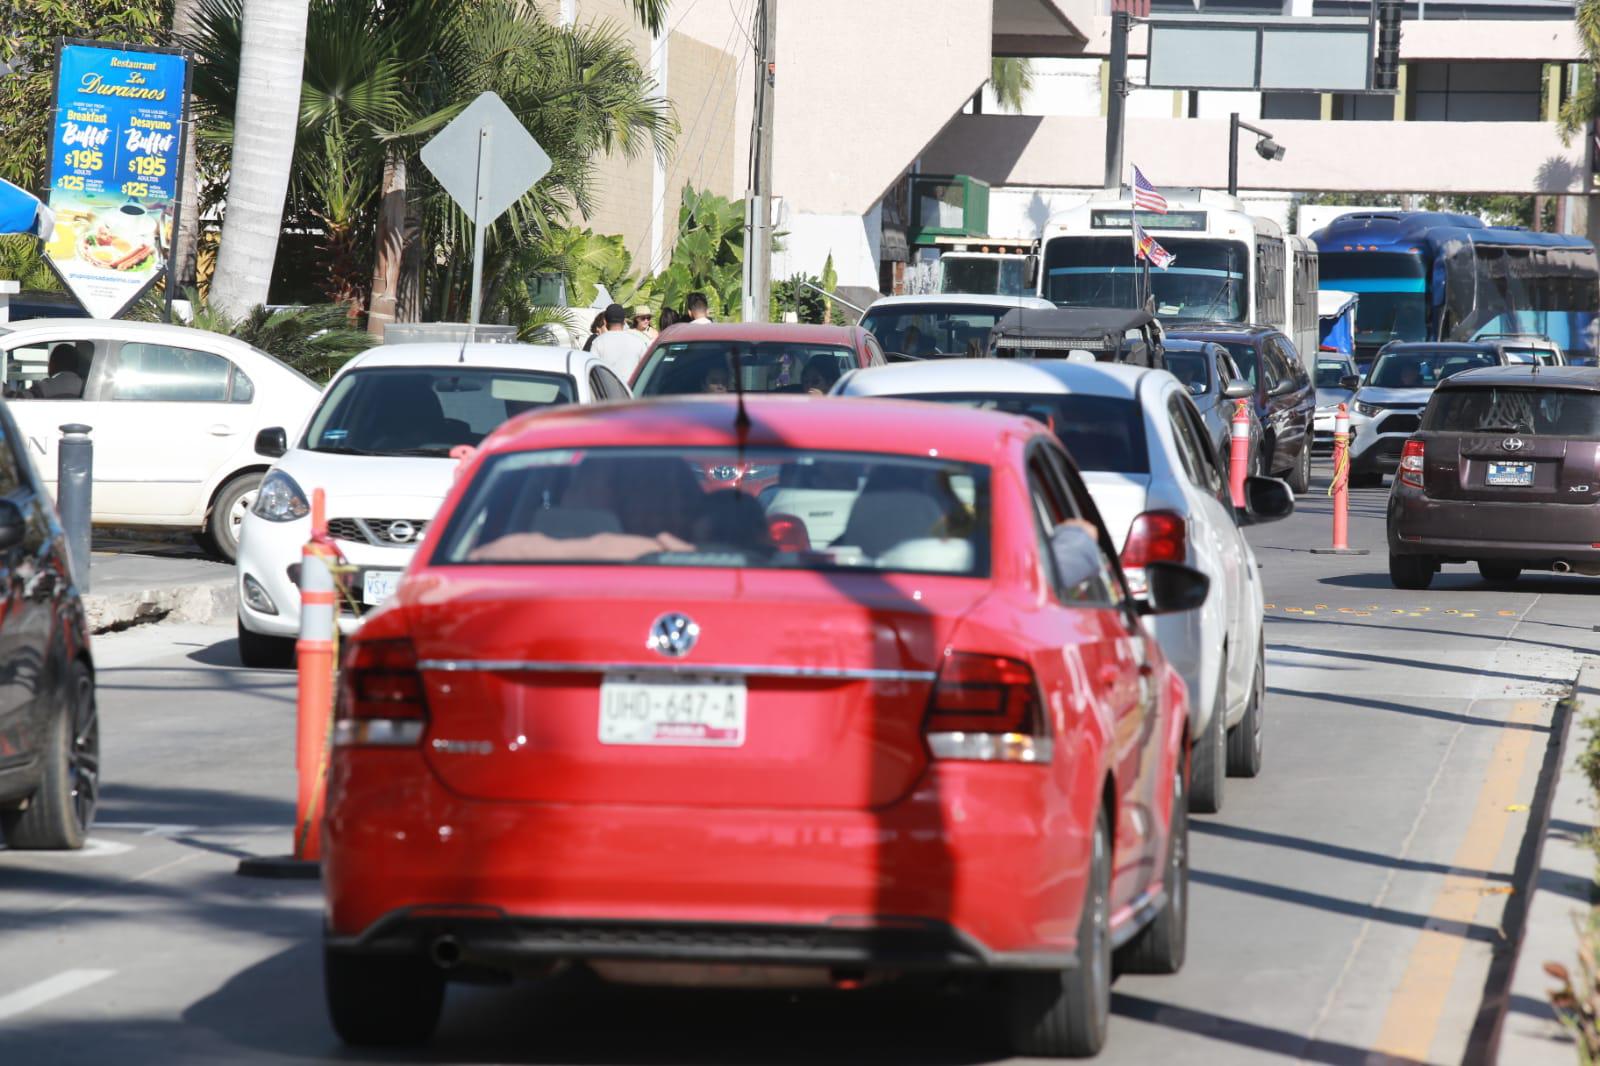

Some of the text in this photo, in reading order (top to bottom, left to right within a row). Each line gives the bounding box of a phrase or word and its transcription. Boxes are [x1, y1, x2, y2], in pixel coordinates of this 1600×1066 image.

[110, 57, 156, 70] Restaurant
[78, 72, 166, 100] Duraznos
[67, 110, 108, 124] Breakfast
[130, 116, 171, 130] Desayuno
[60, 122, 112, 148] Buffet
[124, 128, 176, 154] Buffet
[64, 150, 103, 170] $195
[128, 156, 166, 176] $195
[58, 175, 84, 191] $125
[122, 182, 148, 197] $125
